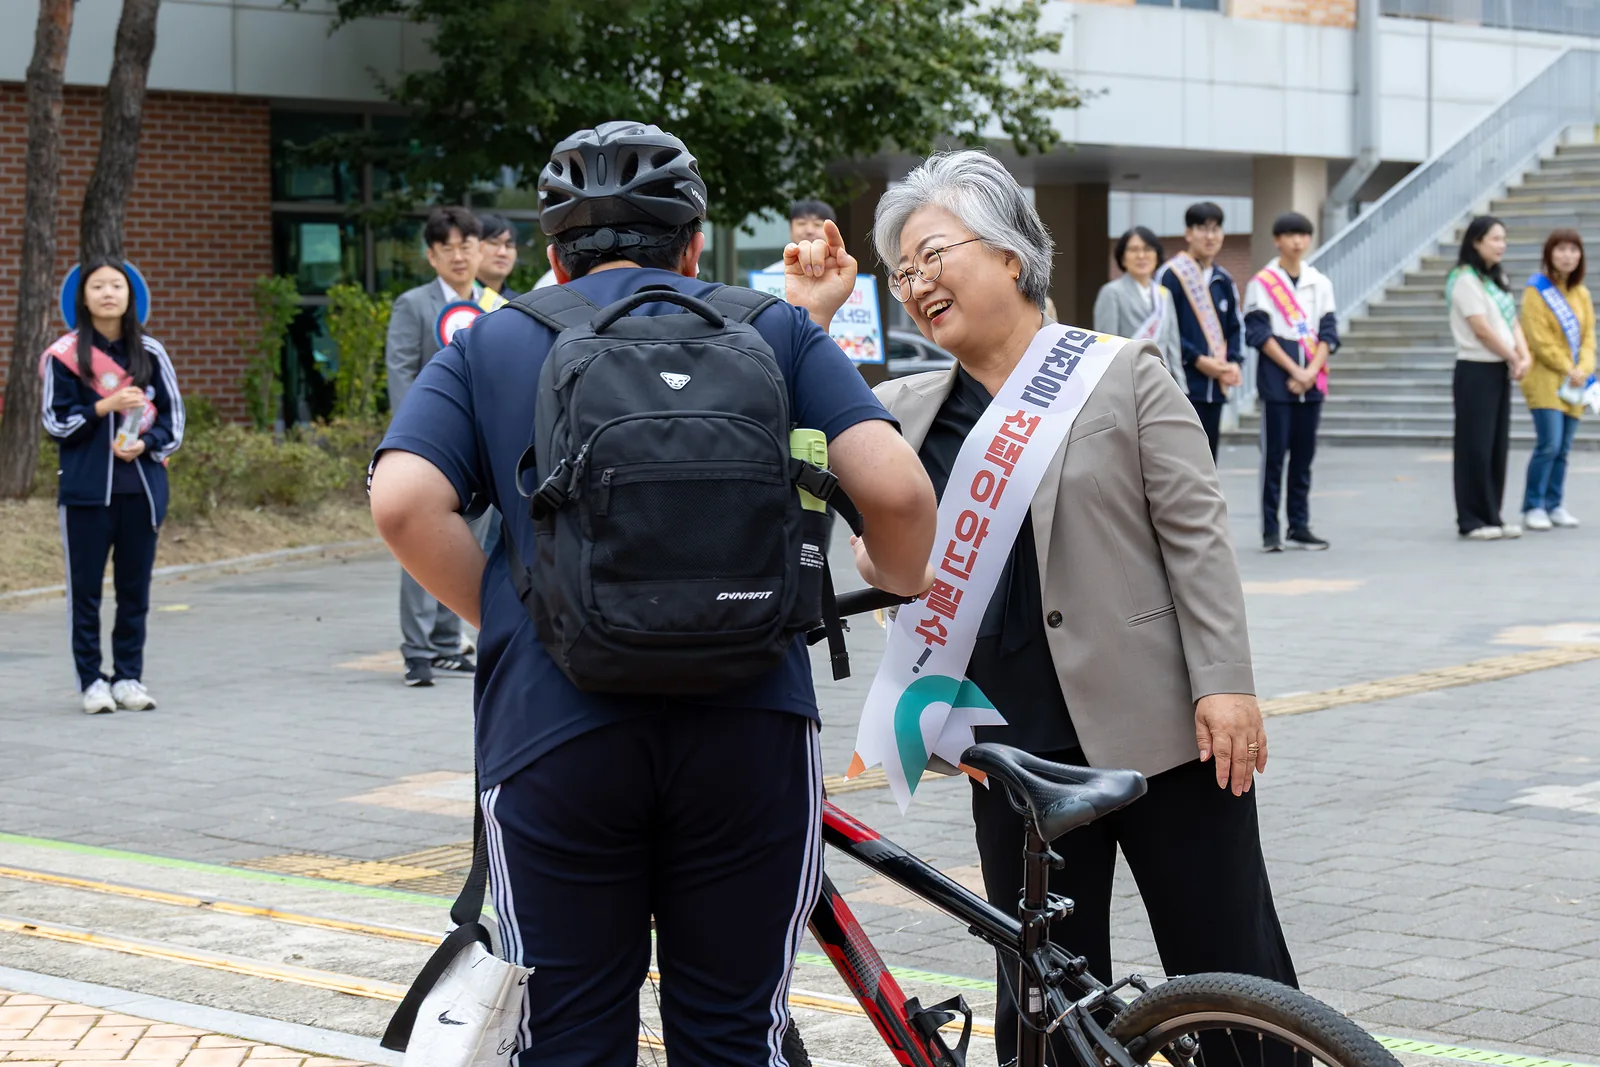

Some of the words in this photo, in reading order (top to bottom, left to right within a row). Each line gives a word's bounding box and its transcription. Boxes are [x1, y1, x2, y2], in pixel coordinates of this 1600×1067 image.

[1020, 330, 1098, 409] 안전은
[970, 409, 1042, 511] 선택이
[940, 509, 990, 581] 아닌
[716, 591, 773, 601] DYNAFIT
[912, 577, 964, 674] 필수!
